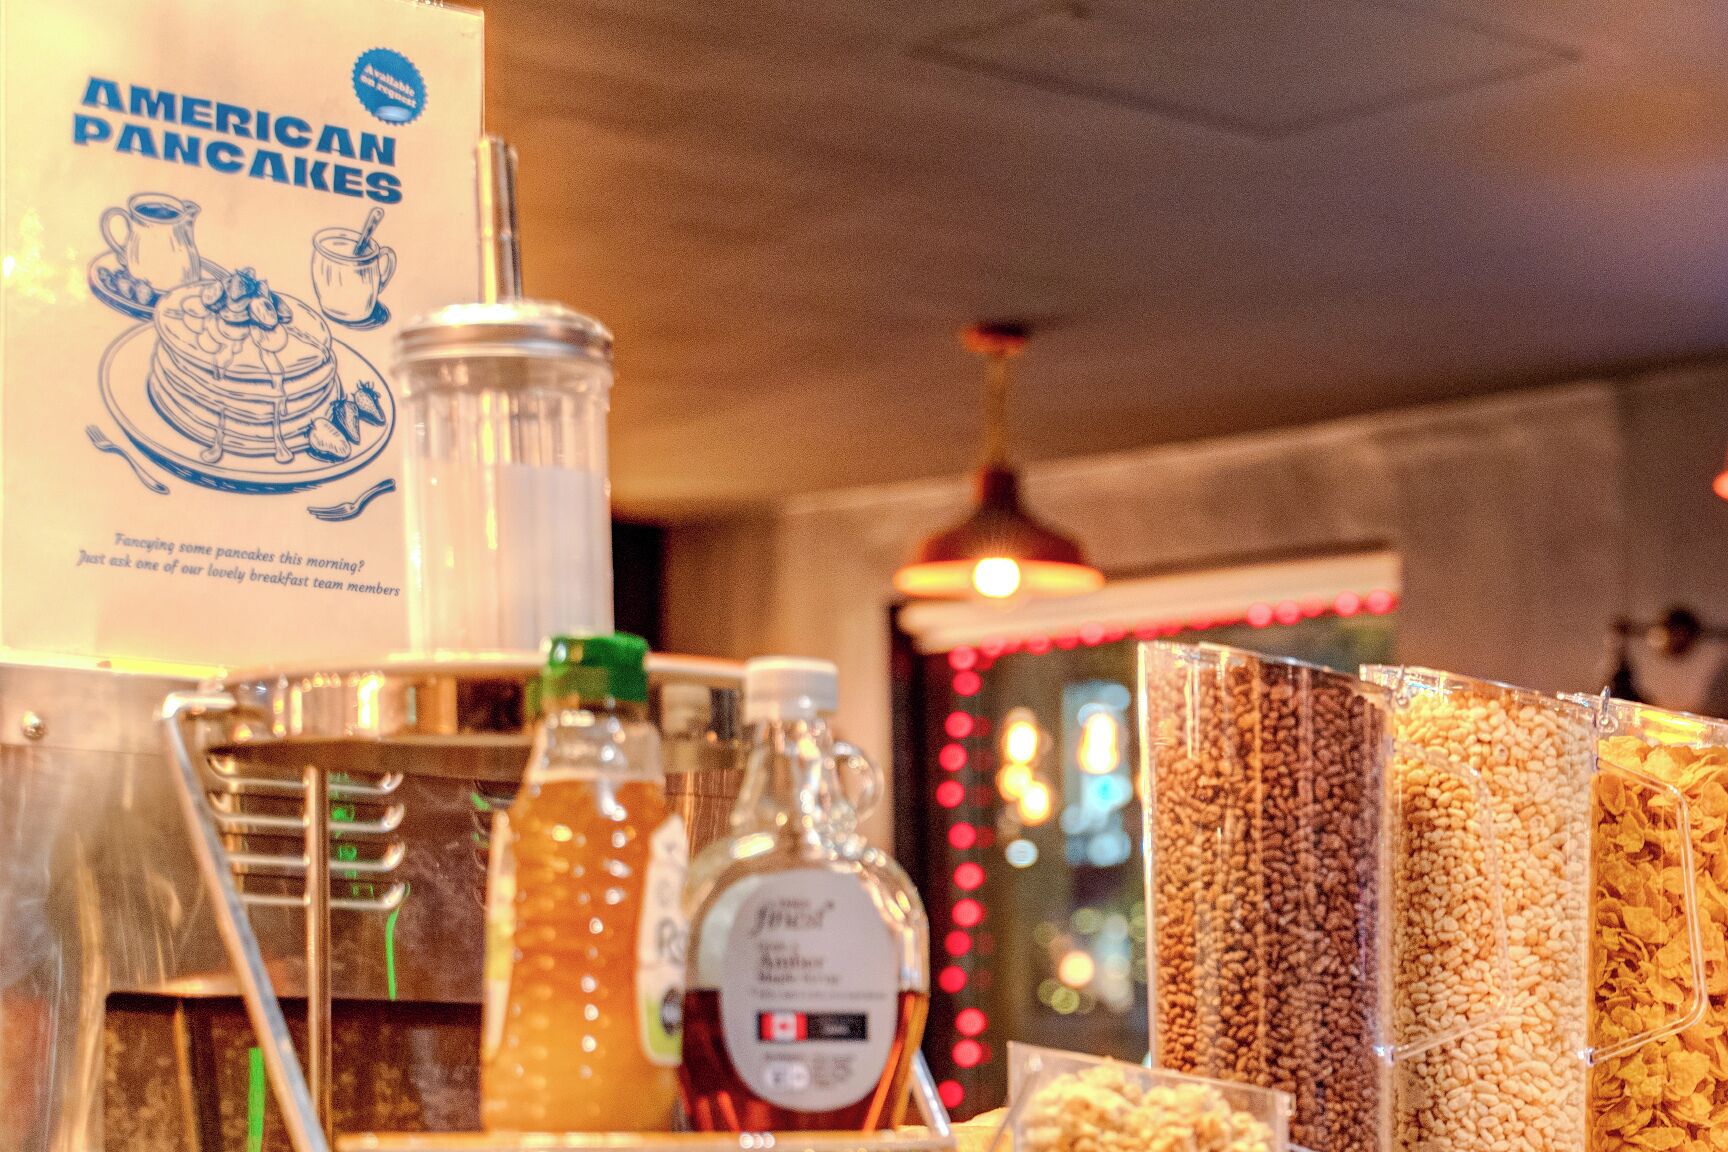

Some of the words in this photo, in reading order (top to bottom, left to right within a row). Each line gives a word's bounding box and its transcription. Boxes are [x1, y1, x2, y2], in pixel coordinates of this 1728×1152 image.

[81, 75, 396, 167] AMERICAN
[72, 112, 403, 205] PANCAKES
[76, 549, 106, 566] Just
[109, 554, 132, 569] ask
[135, 558, 160, 572] one
[163, 559, 180, 575] of
[180, 564, 205, 577] our
[207, 562, 246, 584] lovely
[249, 567, 309, 588] breakfast
[313, 576, 344, 591] team
[346, 581, 401, 598] members
[114, 532, 175, 555] Fancying
[179, 542, 213, 556] some
[215, 546, 275, 563] pancakes
[279, 550, 303, 566] this
[306, 558, 366, 576] morning?
